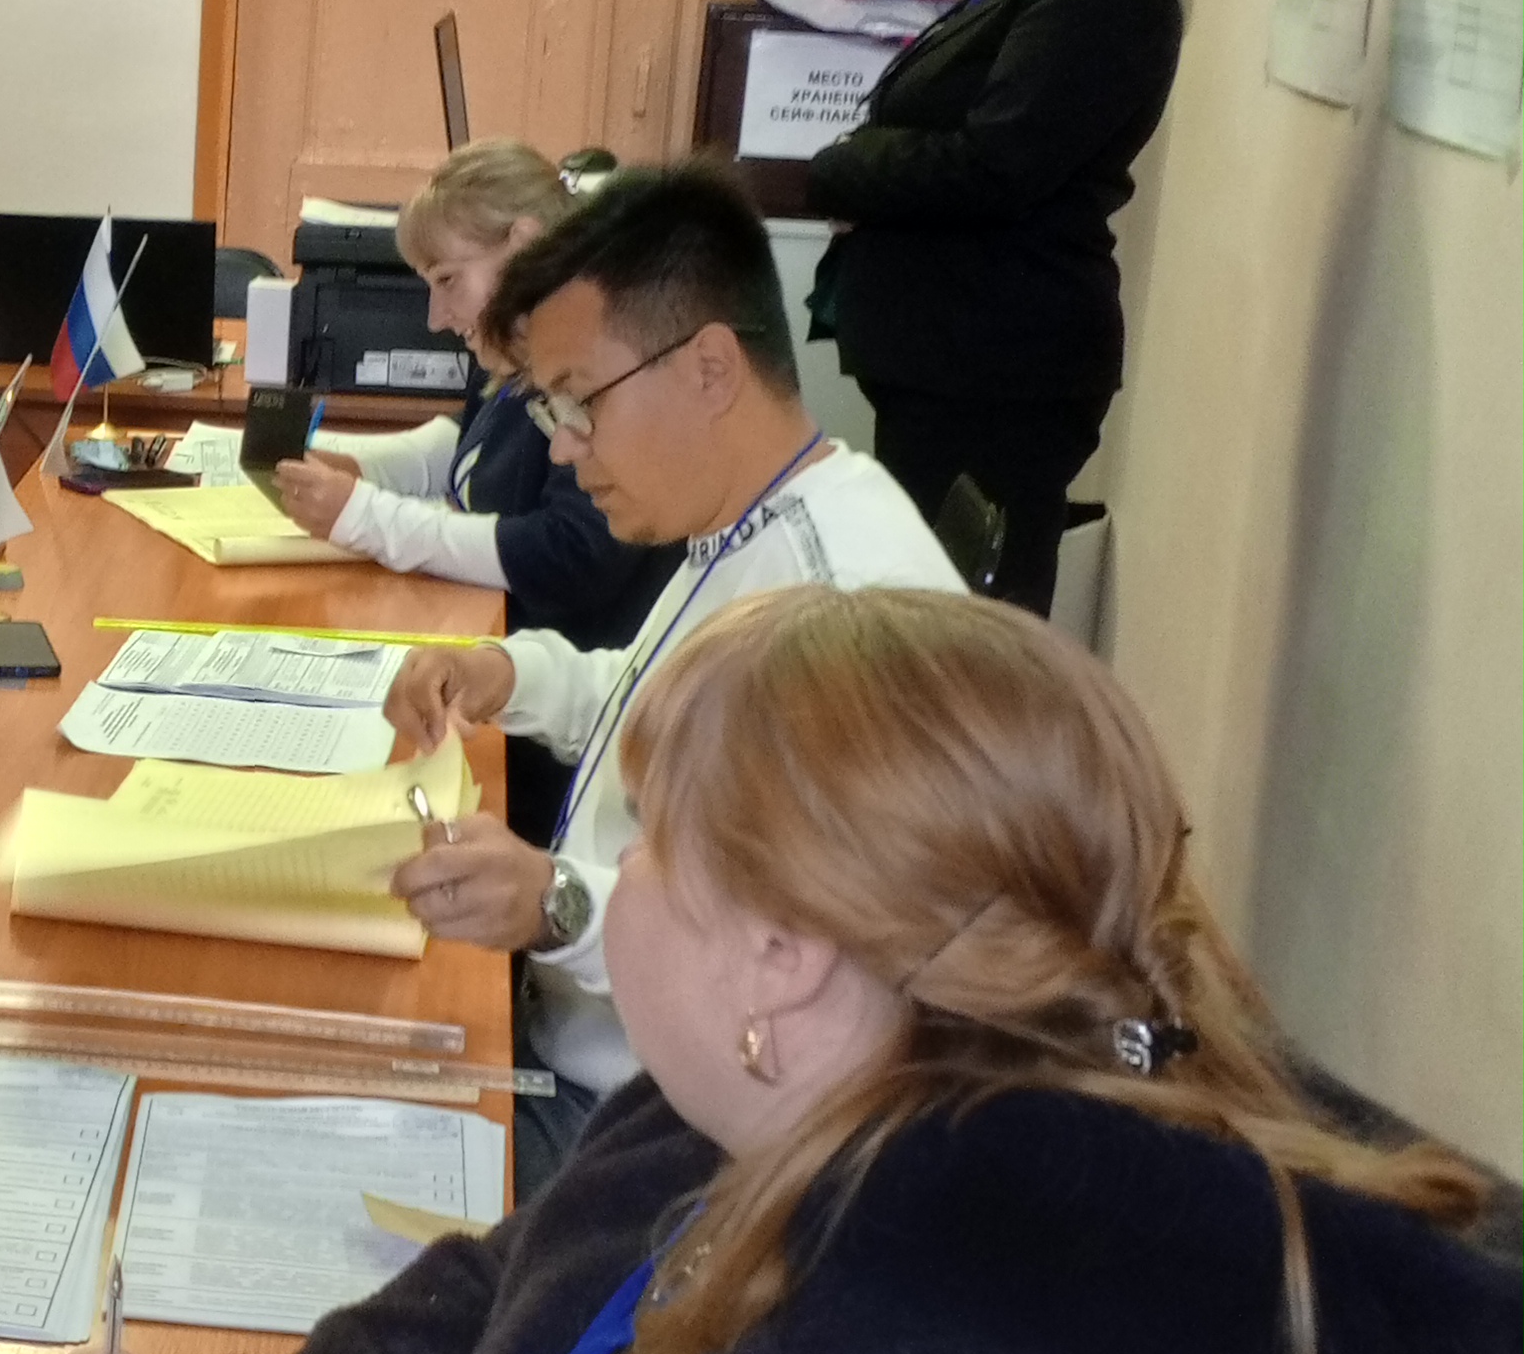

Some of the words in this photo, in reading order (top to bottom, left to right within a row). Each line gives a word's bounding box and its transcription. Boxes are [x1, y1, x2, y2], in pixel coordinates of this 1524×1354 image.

[808, 70, 864, 87] МЕСТО
[791, 88, 865, 104] ХРАНЕНИ
[770, 106, 862, 123] СЕЙФ-ПАКЕ
